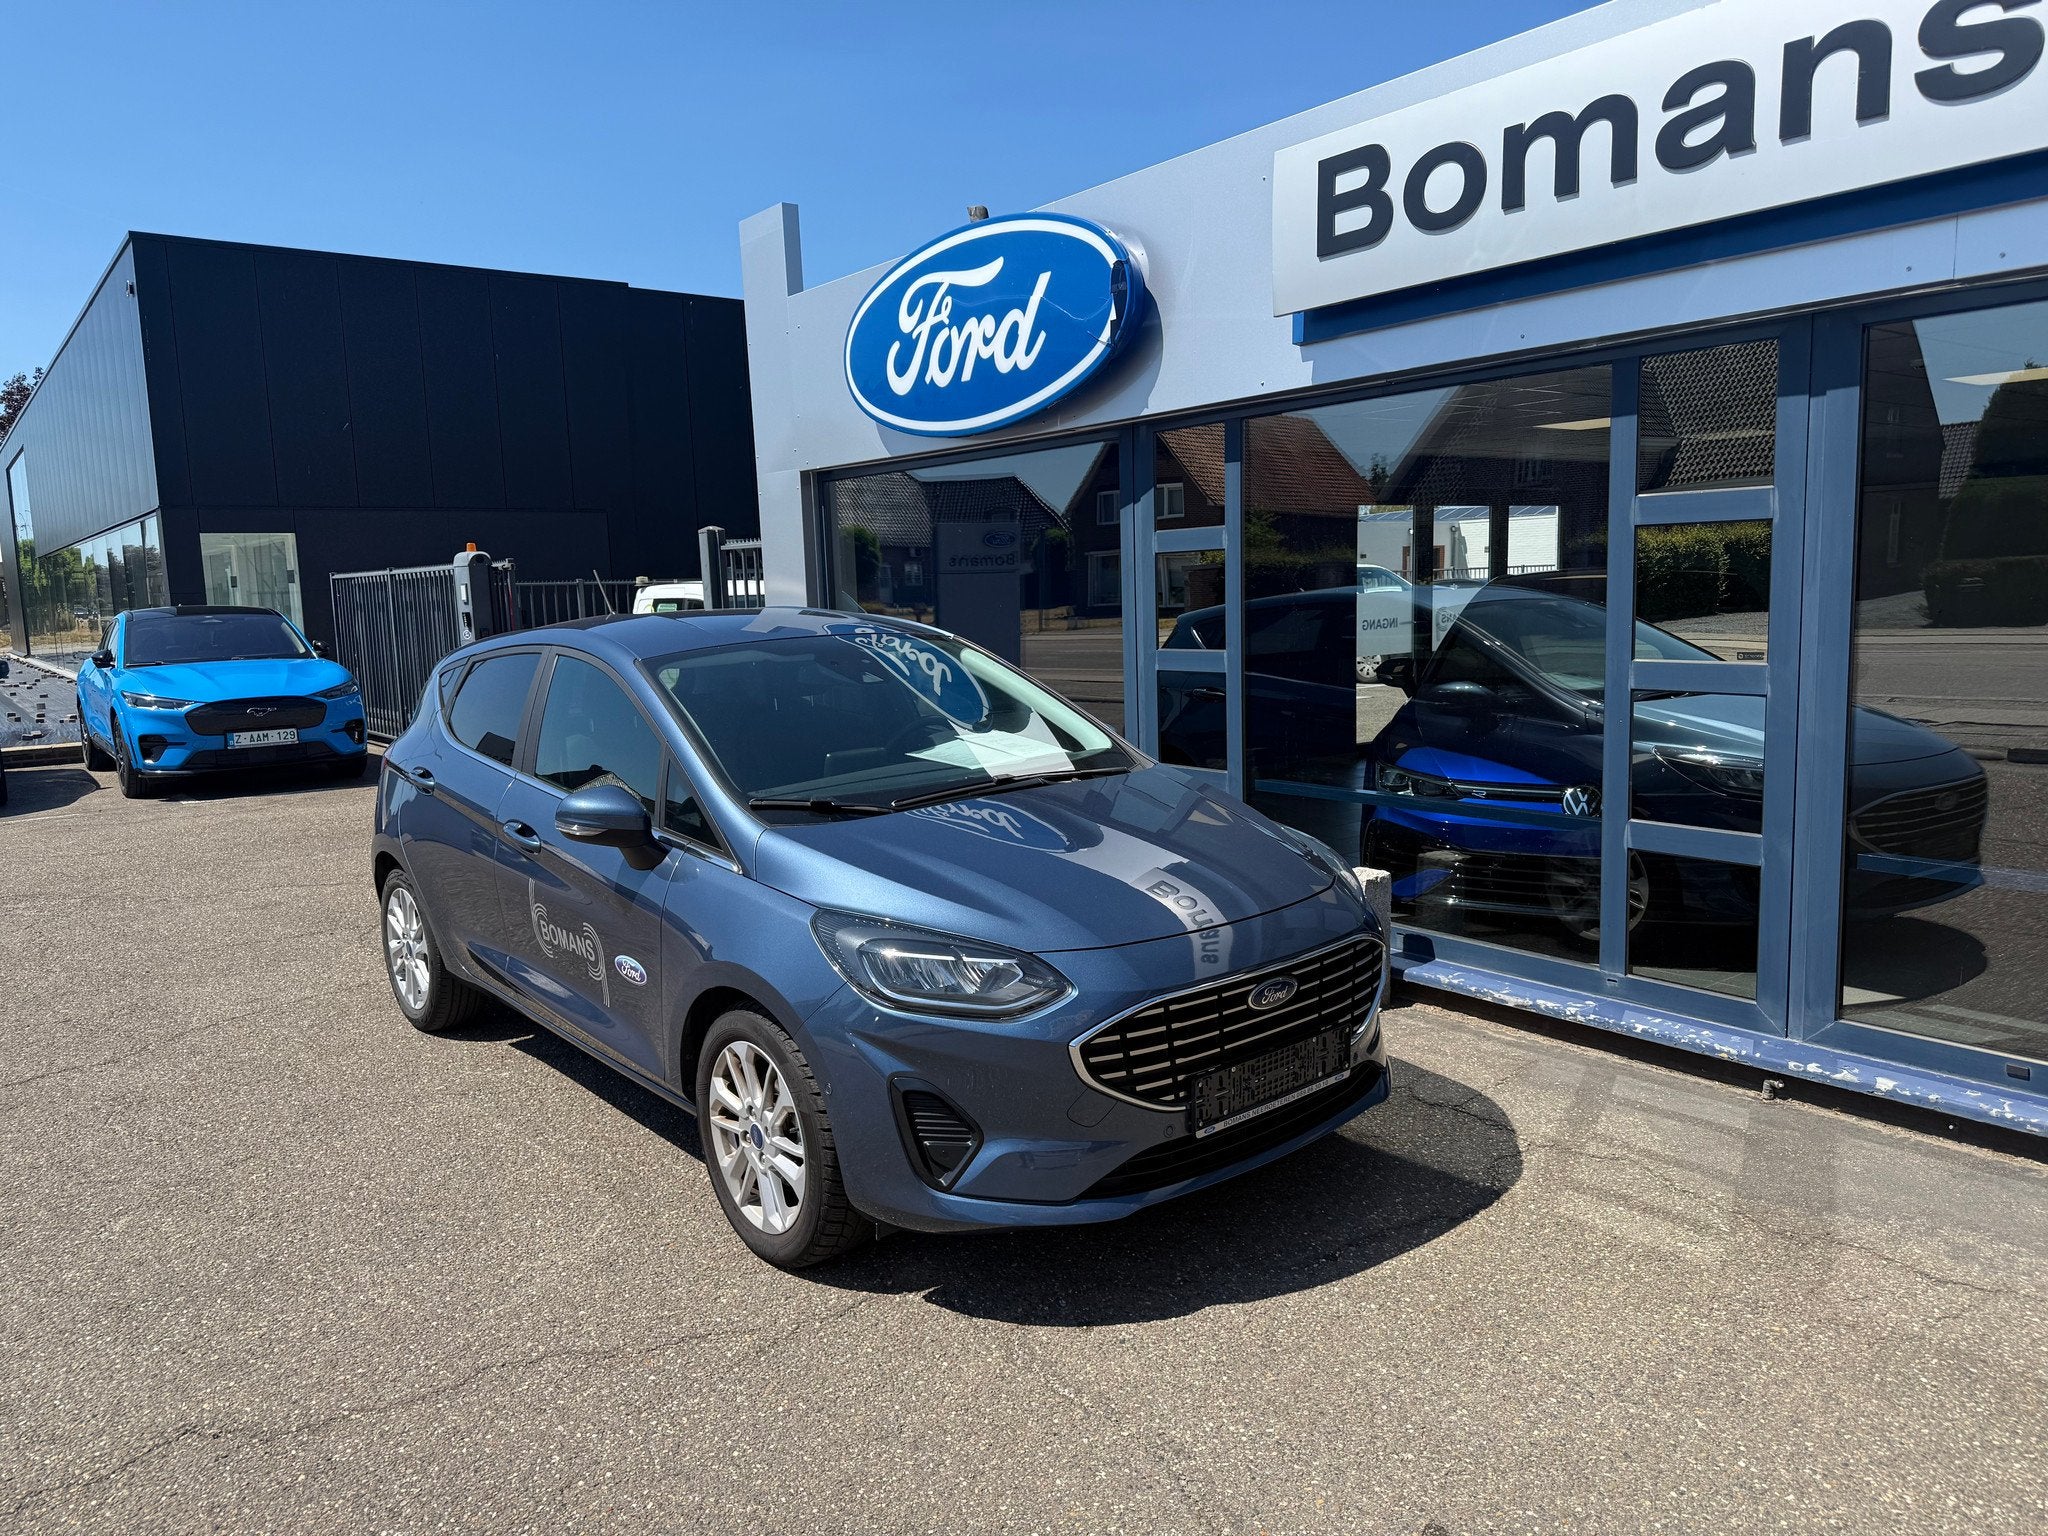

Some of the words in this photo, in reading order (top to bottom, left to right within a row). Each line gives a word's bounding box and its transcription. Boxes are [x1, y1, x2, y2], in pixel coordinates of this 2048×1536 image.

[1316, 0, 2045, 260] Bomans
[887, 256, 1051, 395] Ford
[540, 919, 596, 962] BOMANS
[621, 959, 642, 982] Ford
[1261, 984, 1288, 1004] Ford
[1223, 1111, 1251, 1128] BOMANS
